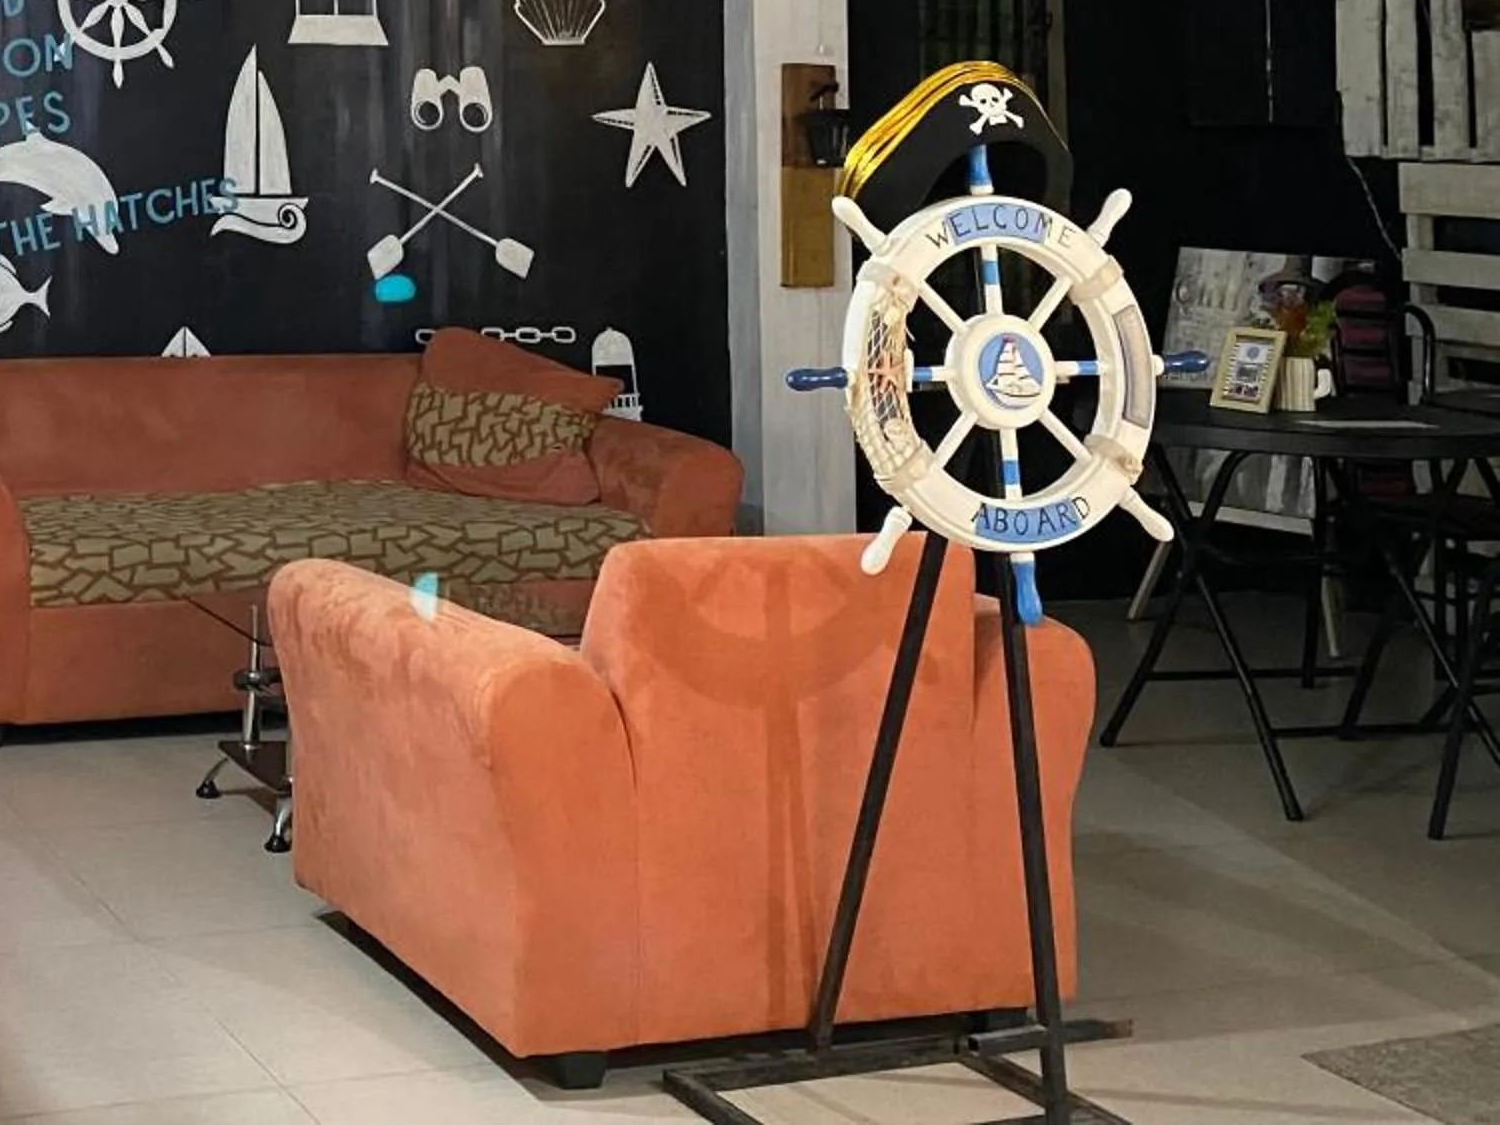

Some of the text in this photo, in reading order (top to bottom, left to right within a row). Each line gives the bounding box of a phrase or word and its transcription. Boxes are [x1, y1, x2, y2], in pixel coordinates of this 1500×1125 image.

[73, 178, 240, 240] HATCHES
[924, 204, 1077, 250] WELCOME
[970, 496, 1090, 536] ABOARD
